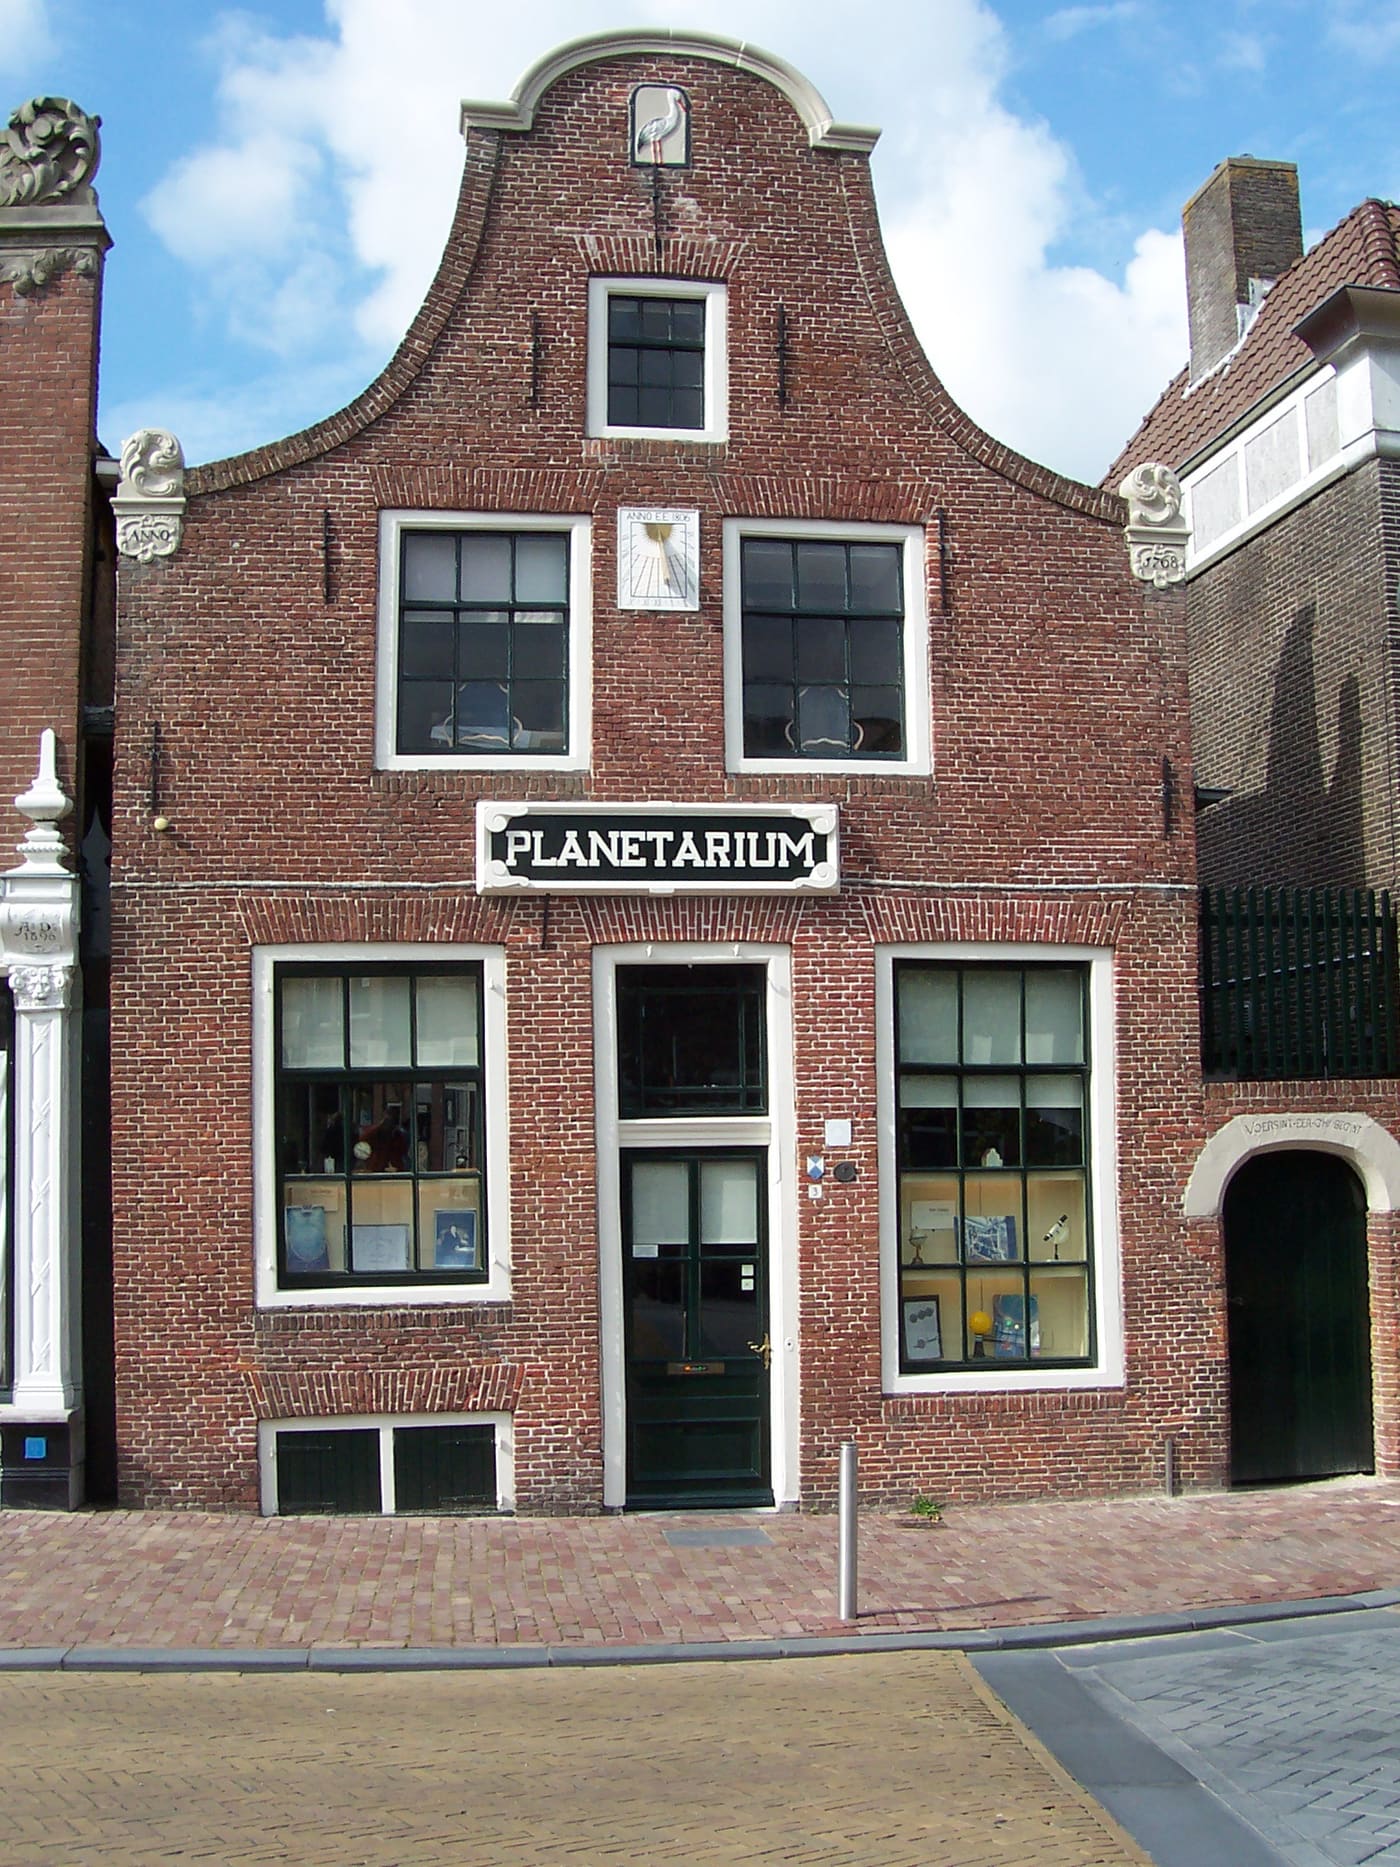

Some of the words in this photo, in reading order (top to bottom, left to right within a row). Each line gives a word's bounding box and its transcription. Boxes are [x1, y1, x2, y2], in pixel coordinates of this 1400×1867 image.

[626, 512, 652, 521] ANNO
[128, 529, 170, 542] ANNO
[1143, 555, 1178, 569] 1768
[505, 830, 815, 868] PLANETARIUM
